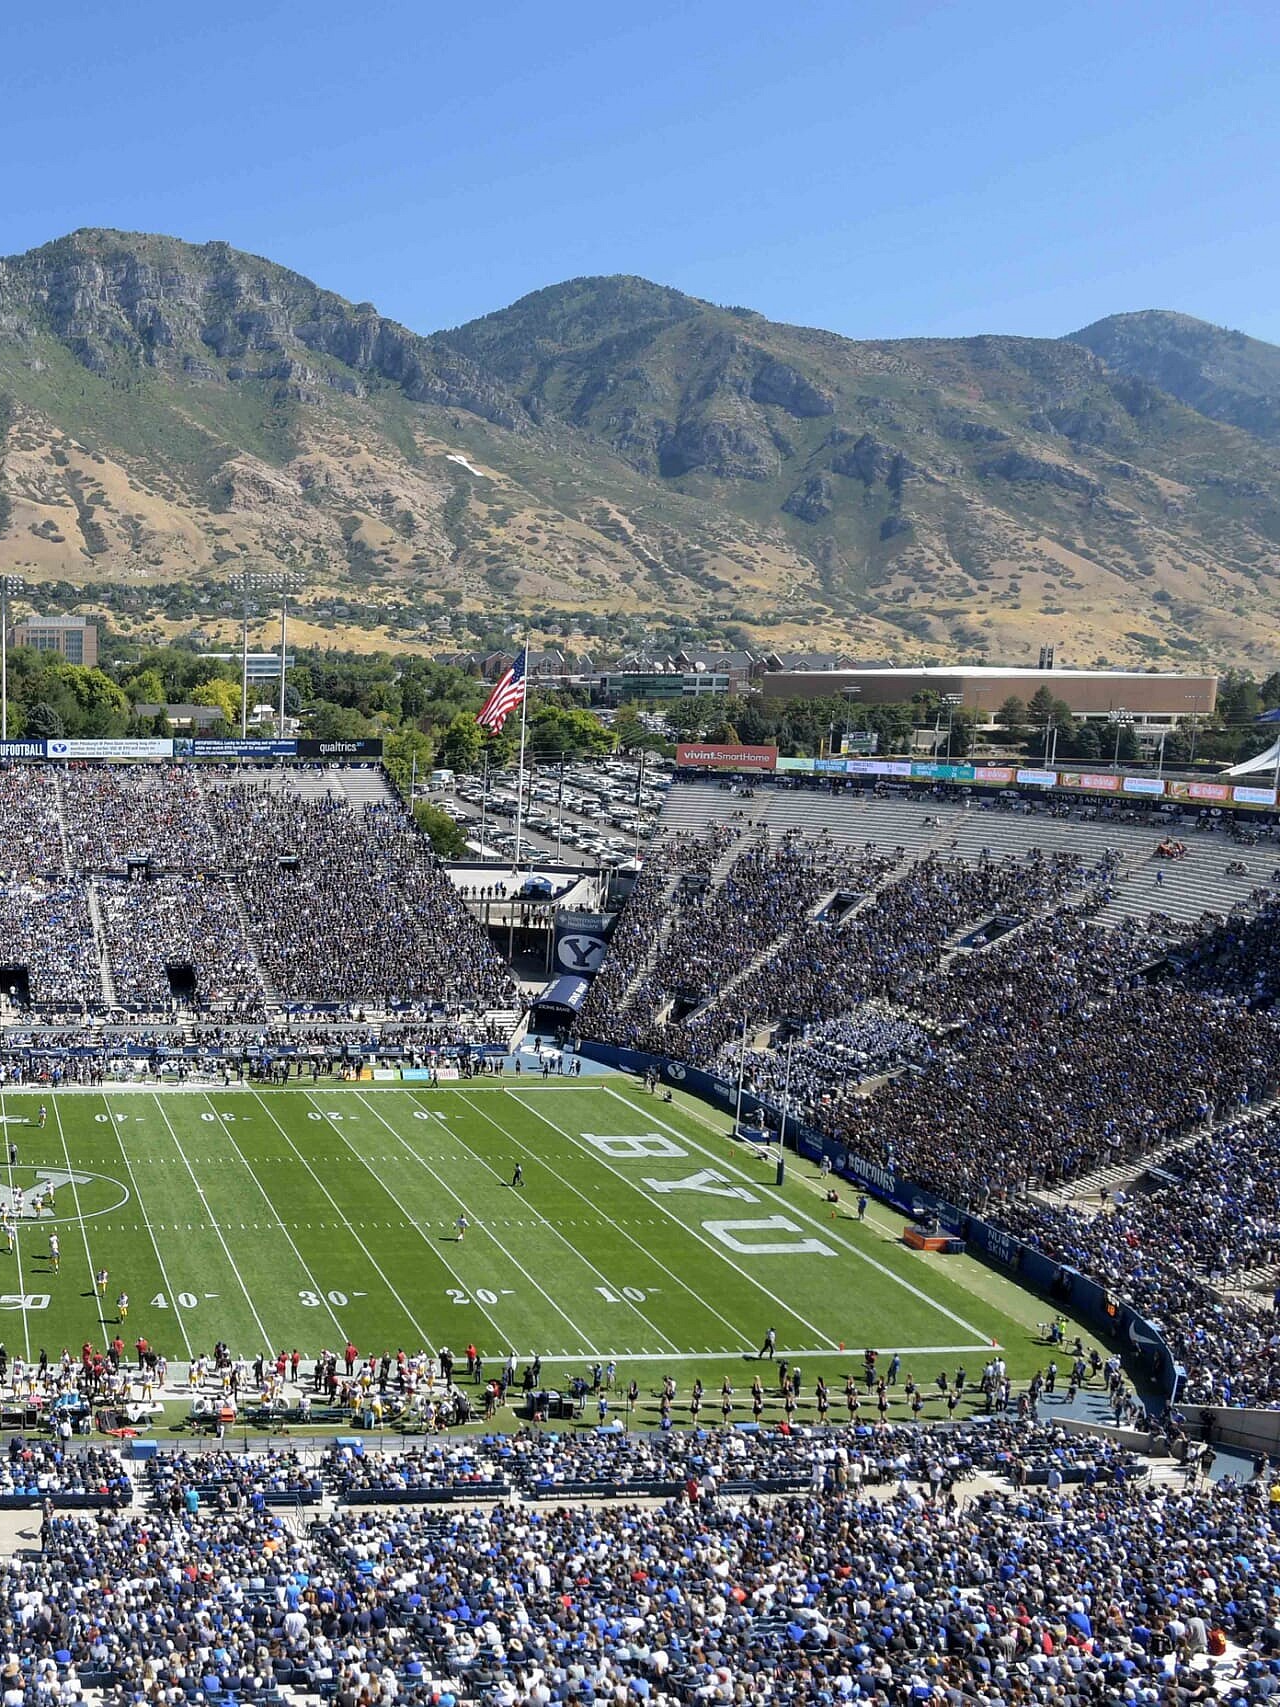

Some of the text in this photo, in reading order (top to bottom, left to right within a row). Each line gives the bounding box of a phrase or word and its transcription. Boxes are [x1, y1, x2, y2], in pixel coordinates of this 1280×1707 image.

[319, 742, 357, 754] qualtrics
[848, 1153, 896, 1193] #GOCOUGS
[580, 1131, 839, 1257] BYU
[987, 1241, 1009, 1261] SKIN
[150, 1292, 198, 1308] 40
[298, 1290, 349, 1306] 30
[445, 1288, 498, 1304] 20
[593, 1286, 647, 1303] 10
